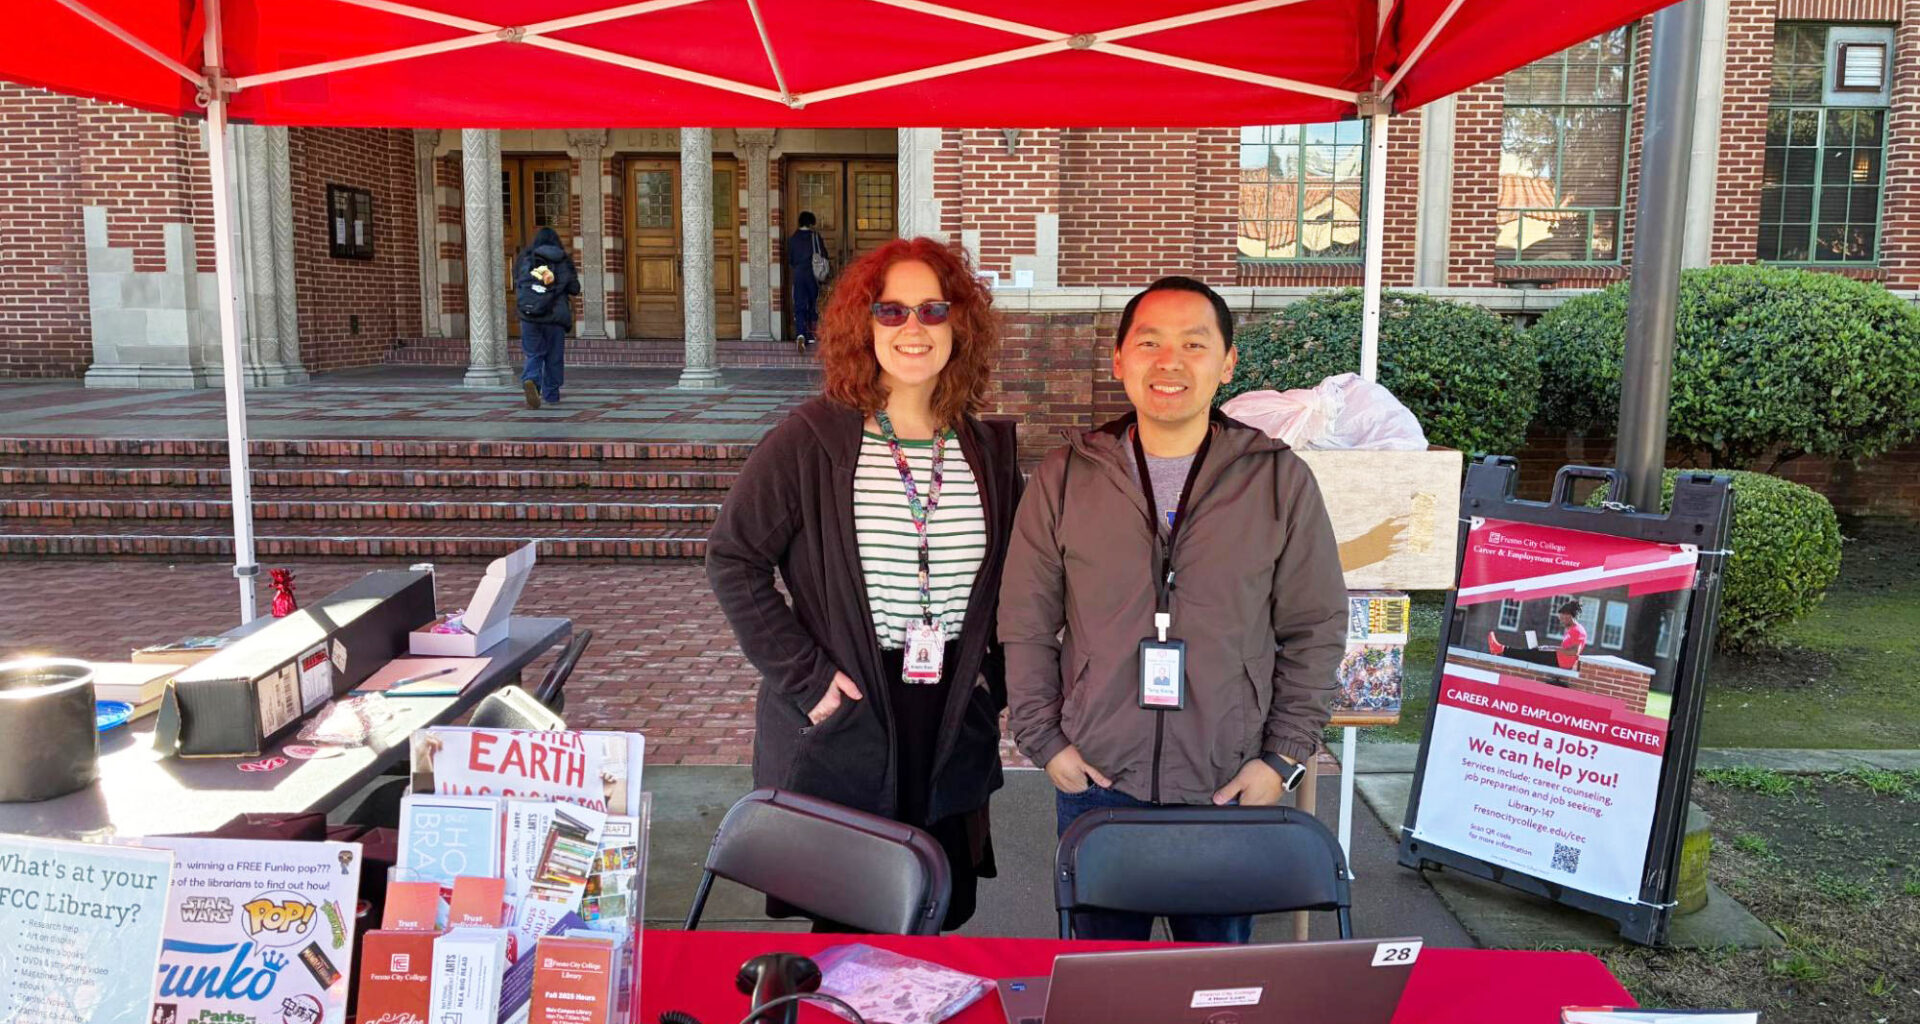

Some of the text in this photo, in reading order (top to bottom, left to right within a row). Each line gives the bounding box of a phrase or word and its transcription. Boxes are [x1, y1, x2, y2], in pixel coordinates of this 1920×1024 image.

[1500, 535, 1566, 552] Fresno City College
[1474, 545, 1496, 554] Career
[1508, 550, 1554, 563] Employment
[1555, 556, 1580, 567] Center
[1446, 689, 1660, 747] CAREER AND EMPLOYMENT CENTER
[1492, 721, 1598, 760] Need a Job?
[468, 730, 586, 788] EARTH
[1468, 736, 1618, 789] We can help you!
[1462, 757, 1495, 774] Services
[1532, 778, 1560, 791] career
[1464, 772, 1478, 782] job
[1480, 778, 1530, 796] preparation
[1532, 790, 1548, 801] and
[1550, 792, 1566, 806] job
[528, 812, 538, 830] ARTS
[1474, 804, 1587, 844] Fresnocitycollege.edu/cec
[1470, 823, 1512, 840] Scan QR code
[1468, 831, 1532, 856] for more information
[0, 854, 158, 892] What's at your
[187, 861, 224, 871] winning
[236, 862, 262, 872] FREE
[264, 862, 295, 872] Funko
[298, 864, 331, 874] pop???
[176, 878, 187, 886] of
[189, 878, 206, 887] the
[208, 878, 251, 888] librarians
[254, 880, 264, 888] to
[267, 880, 286, 889] find
[288, 882, 304, 890] out
[306, 882, 330, 891] how!
[0, 886, 141, 928] FCC Library?
[183, 896, 233, 910] STAR
[181, 908, 233, 923] WARS
[242, 898, 317, 936] POP!
[463, 914, 482, 922] Trust
[29, 919, 79, 934] Research help
[26, 932, 38, 940] Art
[22, 956, 42, 966] DVDs
[1382, 947, 1412, 962] 28
[445, 954, 457, 973] ARTS
[582, 962, 601, 970] College
[391, 974, 404, 982] City
[404, 974, 428, 982] College
[561, 972, 583, 980] Library
[576, 993, 596, 1002] Hours
[200, 1010, 245, 1022] Parks
